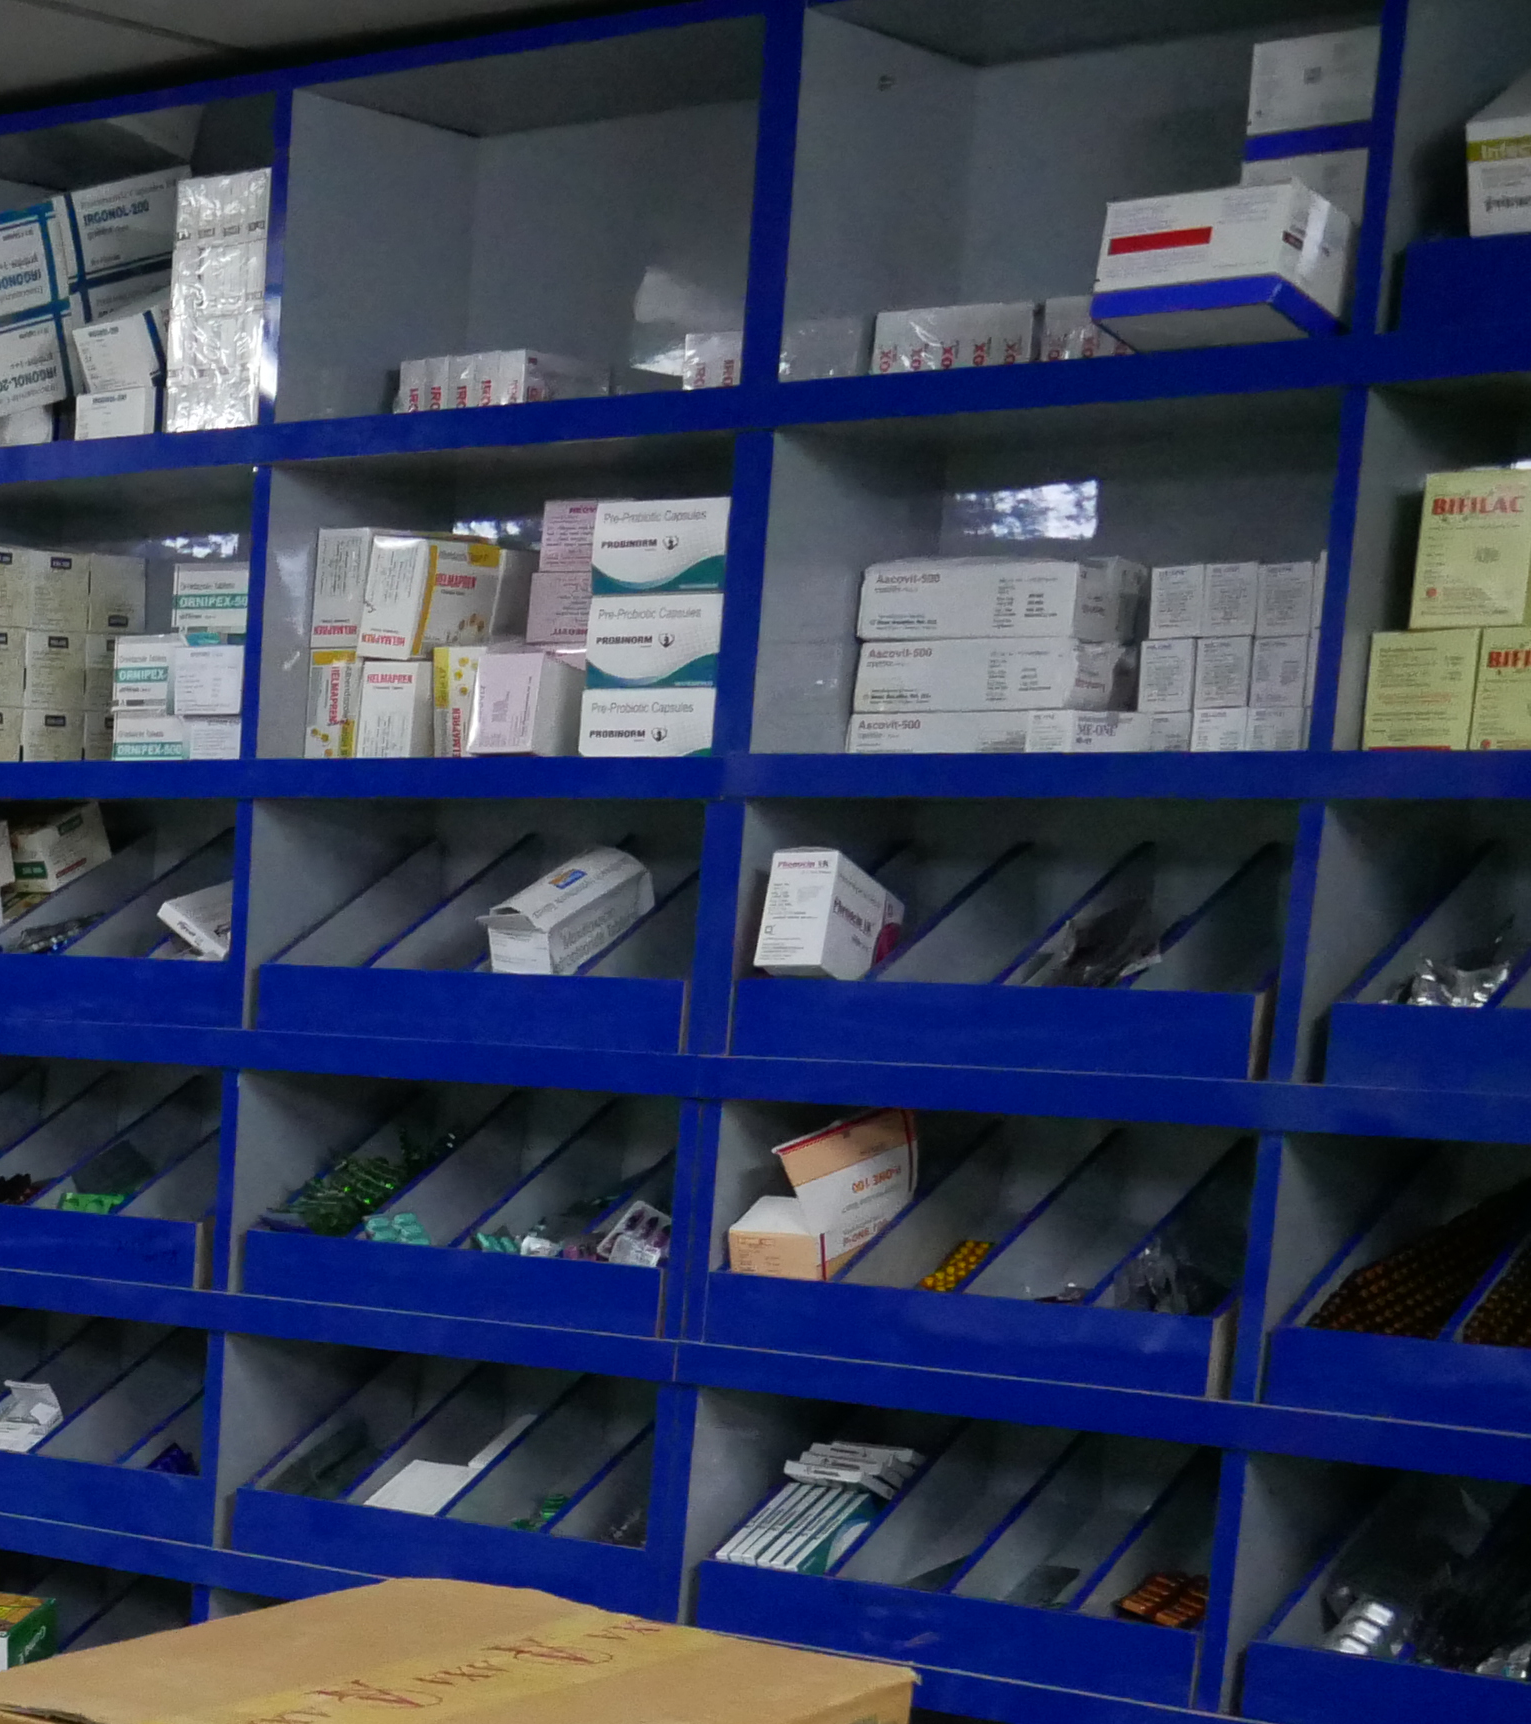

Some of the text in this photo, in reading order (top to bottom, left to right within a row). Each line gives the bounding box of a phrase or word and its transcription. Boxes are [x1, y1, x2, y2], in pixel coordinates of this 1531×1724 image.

[1431, 496, 1524, 516] BIFILAC
[664, 508, 707, 522] Capsules
[601, 537, 658, 550] PROBINORM
[659, 606, 702, 620] Capsules
[596, 634, 653, 647] PROBINORM
[651, 702, 694, 715] Capsules
[452, 707, 462, 758] ELMAPREN
[589, 728, 646, 740] PROBINORM
